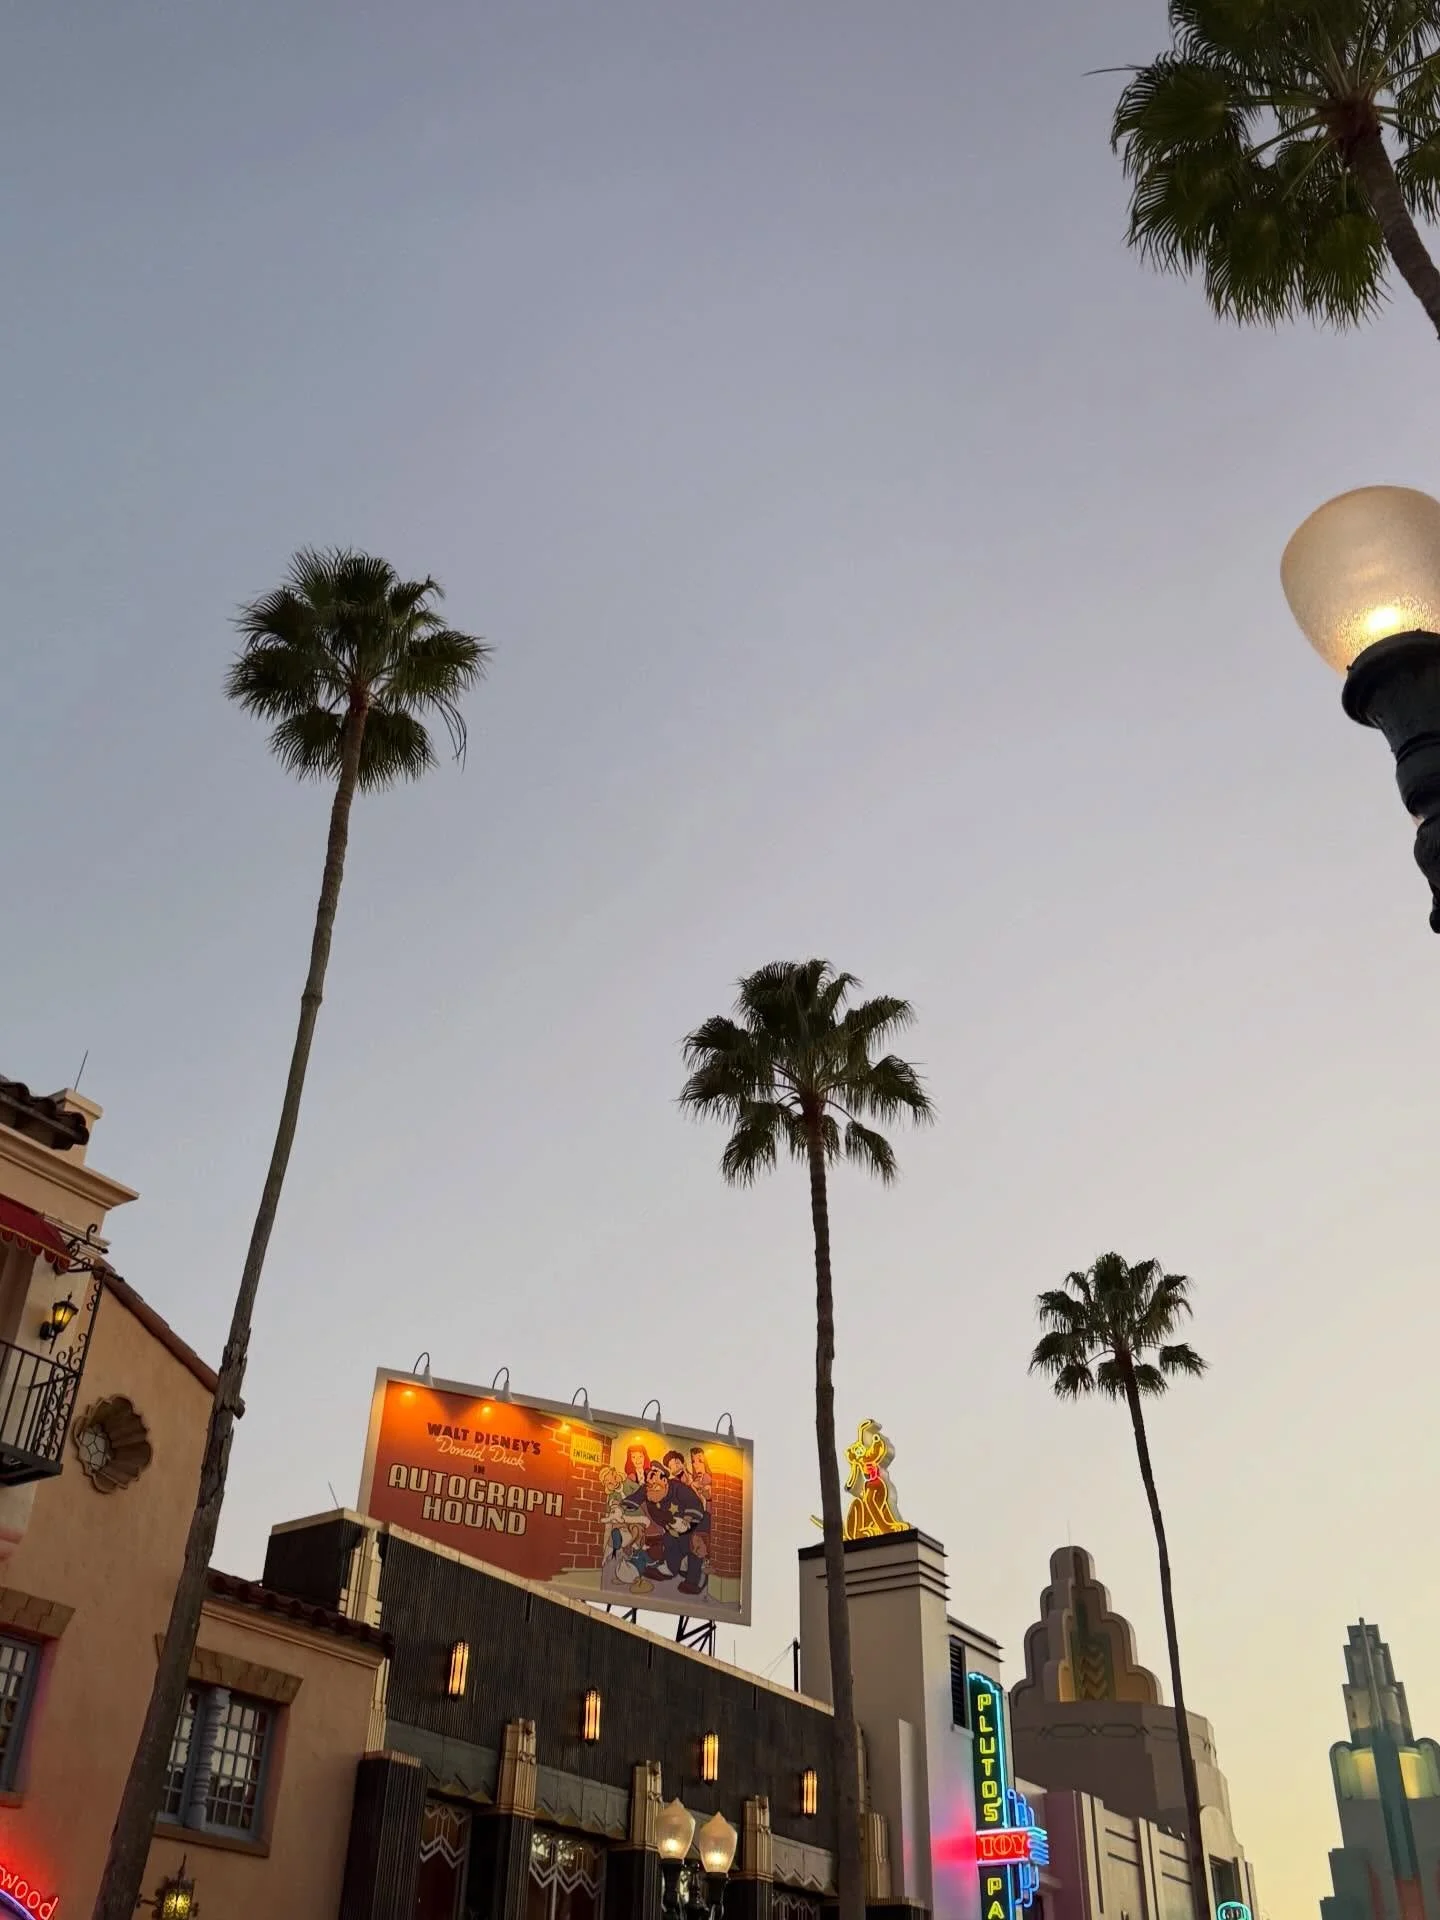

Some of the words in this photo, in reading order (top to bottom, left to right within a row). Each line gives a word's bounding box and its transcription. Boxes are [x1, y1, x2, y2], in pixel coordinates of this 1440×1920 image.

[427, 1422, 470, 1442] WALT
[474, 1430, 542, 1456] DISNEY'S
[435, 1434, 485, 1462] Donald
[488, 1444, 526, 1471] Duck
[473, 1464, 486, 1474] IN
[387, 1462, 565, 1518] AUTOGRAPH
[421, 1494, 527, 1536] HOUND
[977, 1694, 1003, 1823] PLUTO'S
[980, 1834, 1026, 1857] TOY
[986, 1877, 1005, 1920] PA
